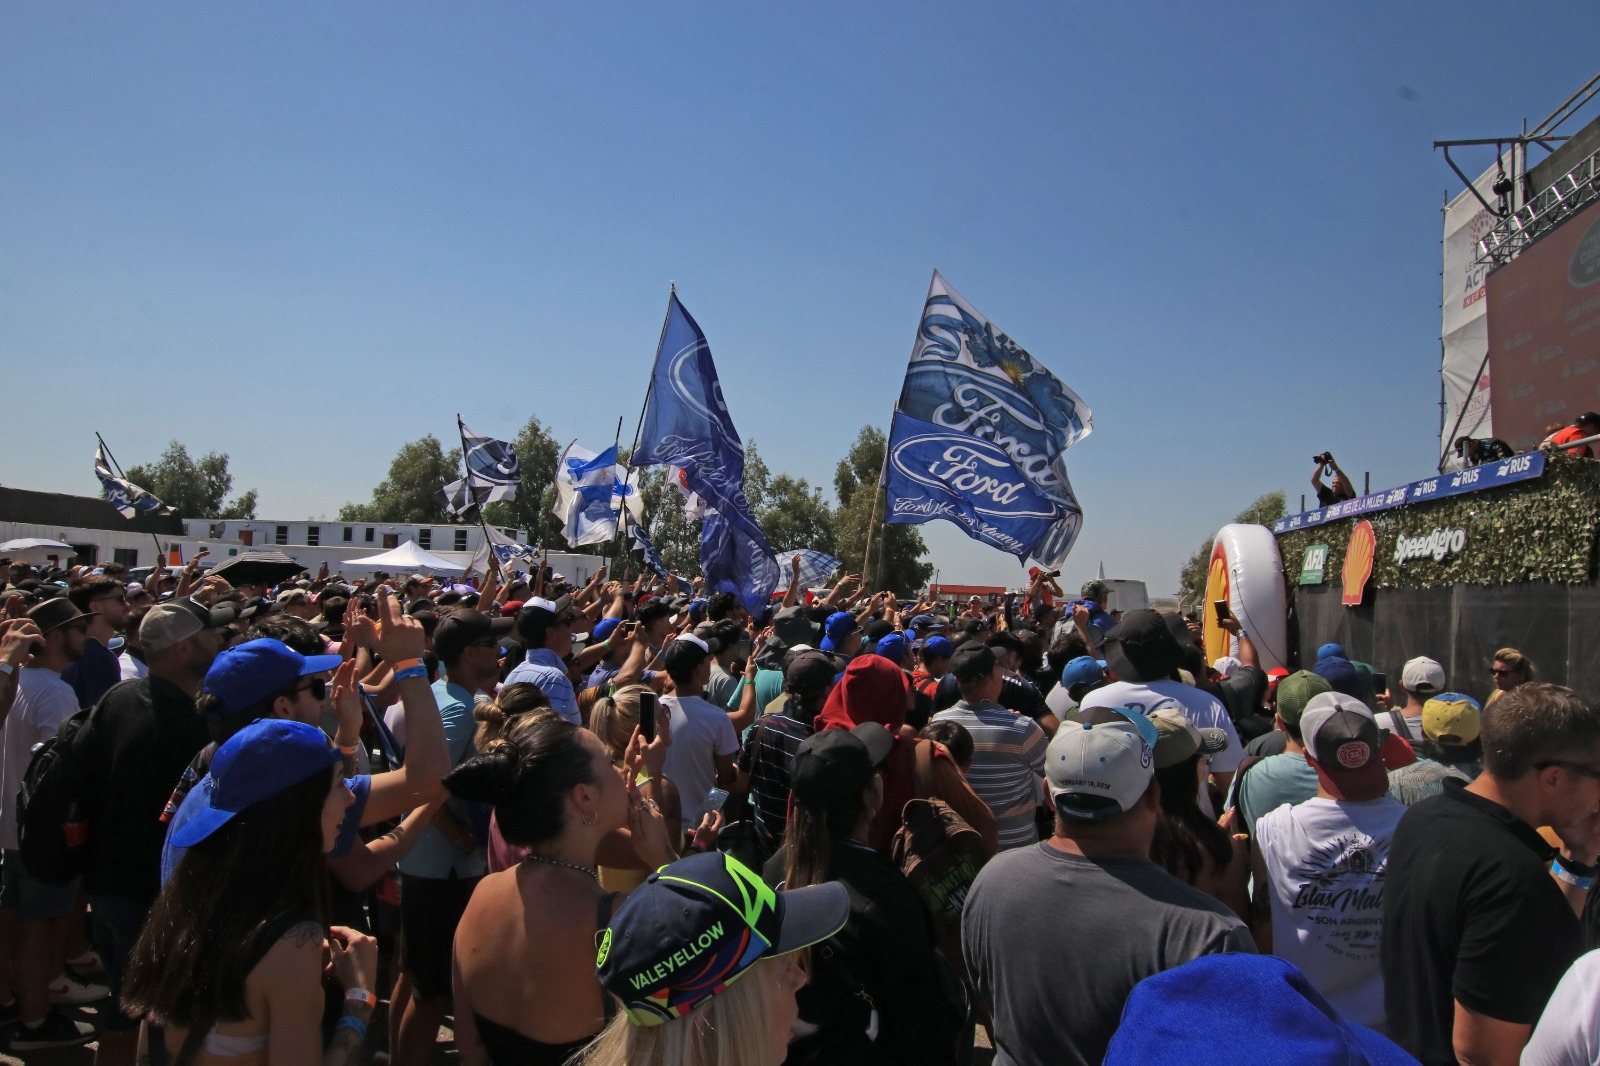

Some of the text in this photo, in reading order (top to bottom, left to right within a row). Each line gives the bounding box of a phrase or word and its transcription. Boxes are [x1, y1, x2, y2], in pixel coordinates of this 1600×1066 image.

[1510, 456, 1531, 474] RUS
[929, 445, 1026, 504] Ford
[1462, 470, 1480, 484] RUS
[1423, 480, 1437, 494] RUS
[1393, 488, 1406, 502] RUS
[1352, 502, 1358, 512] DE
[1358, 500, 1366, 511] LA
[1304, 549, 1323, 570] AFA
[1059, 779, 1086, 787] FEBRUARY
[1292, 884, 1332, 909] Islas
[1315, 916, 1337, 926] SON
[629, 921, 725, 991] VALEYELLOW
